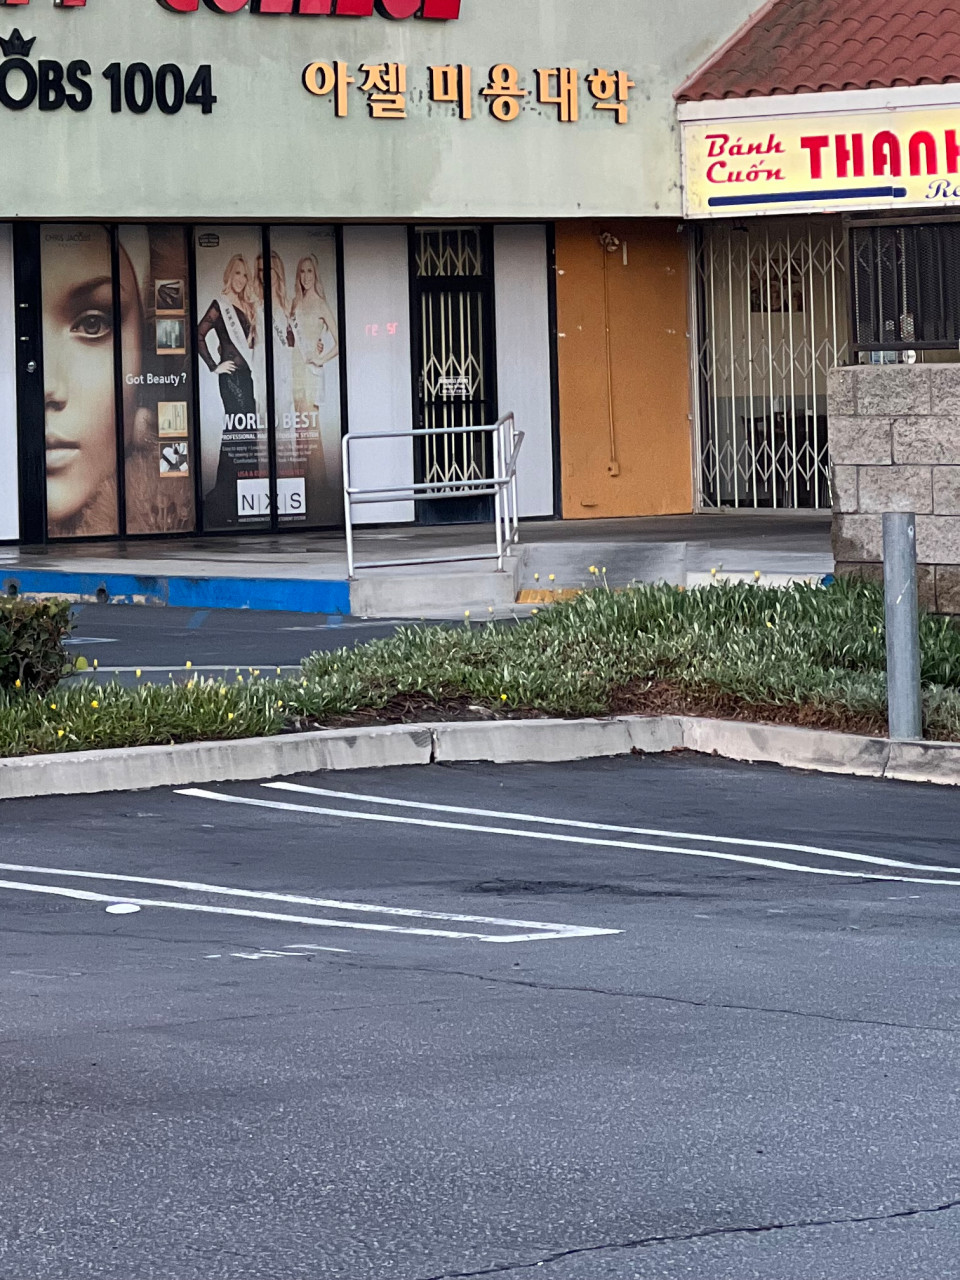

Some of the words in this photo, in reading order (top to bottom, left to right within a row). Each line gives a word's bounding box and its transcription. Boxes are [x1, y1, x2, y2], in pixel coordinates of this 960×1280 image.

[102, 62, 217, 115] 1004
[303, 60, 409, 120] 아젤
[427, 63, 636, 124] 미용대학
[705, 133, 786, 157] Bánh
[705, 160, 786, 184] Cuốn
[125, 373, 145, 385] Got
[282, 411, 318, 429] BEST
